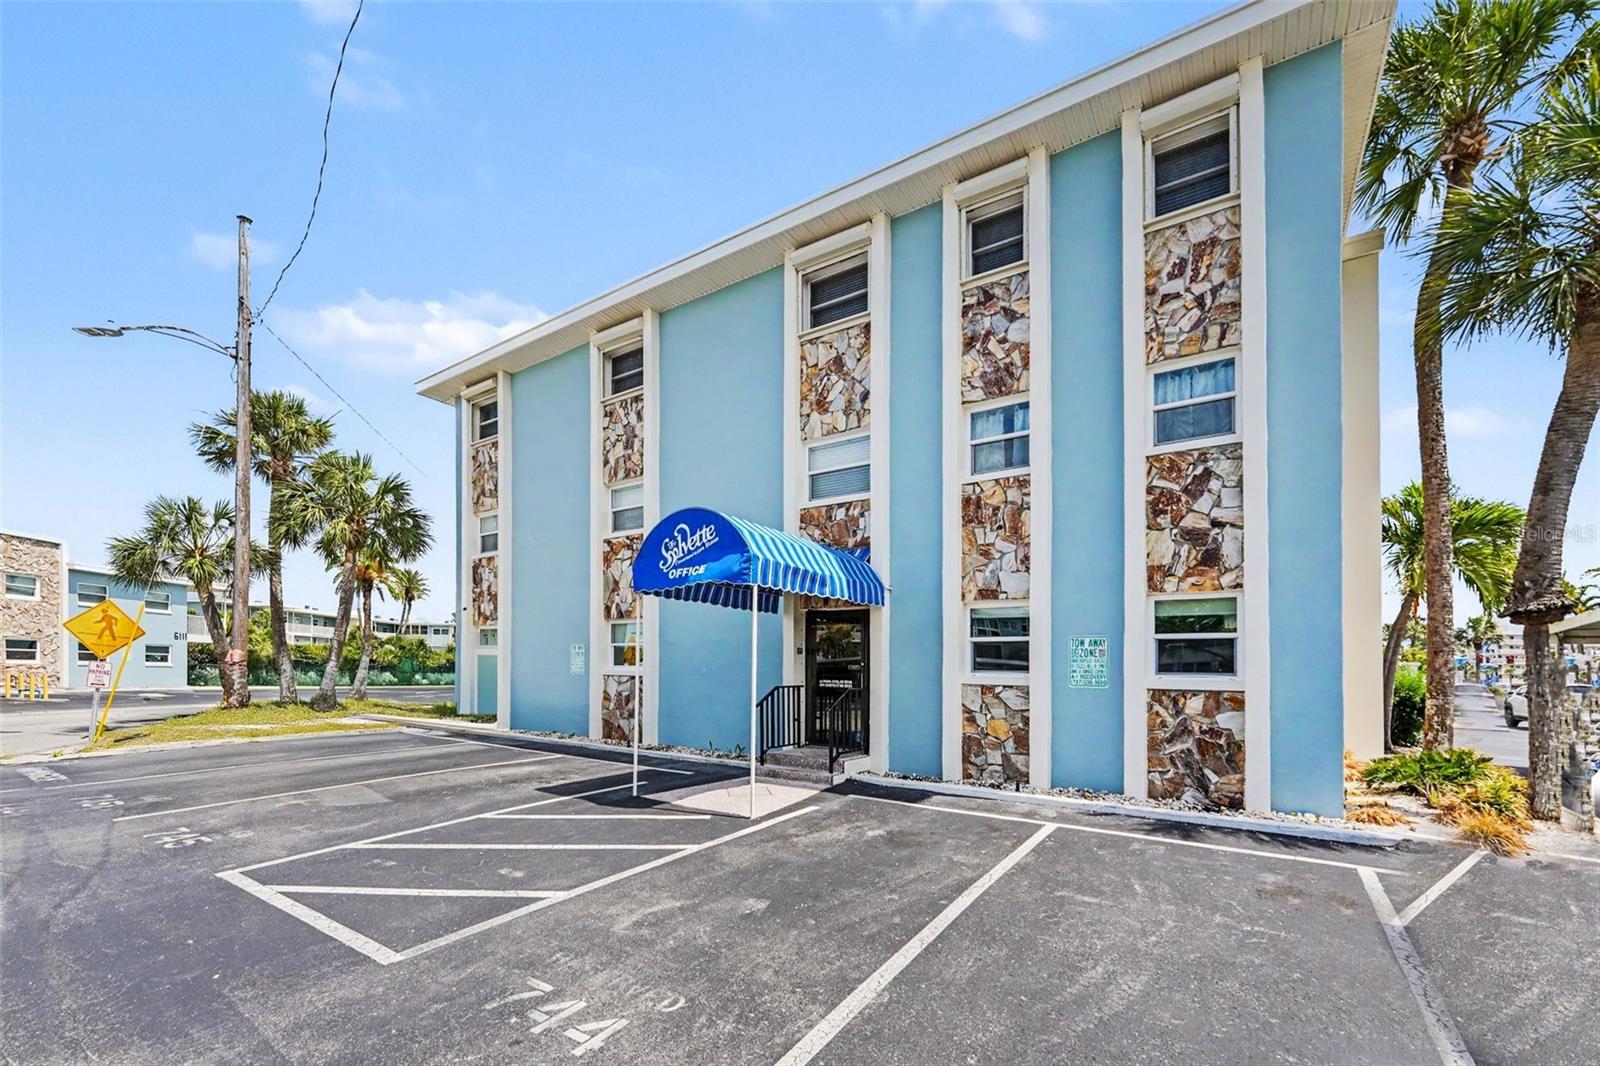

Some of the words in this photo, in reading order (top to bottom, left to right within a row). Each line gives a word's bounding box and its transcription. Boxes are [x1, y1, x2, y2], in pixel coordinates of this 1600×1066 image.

[669, 564, 706, 579] OFFICE
[174, 631, 187, 641] 6111
[1071, 638, 1084, 648] TOW
[1087, 638, 1106, 648] AWAY
[1079, 648, 1098, 658] ZONE
[481, 976, 631, 1057] 744
